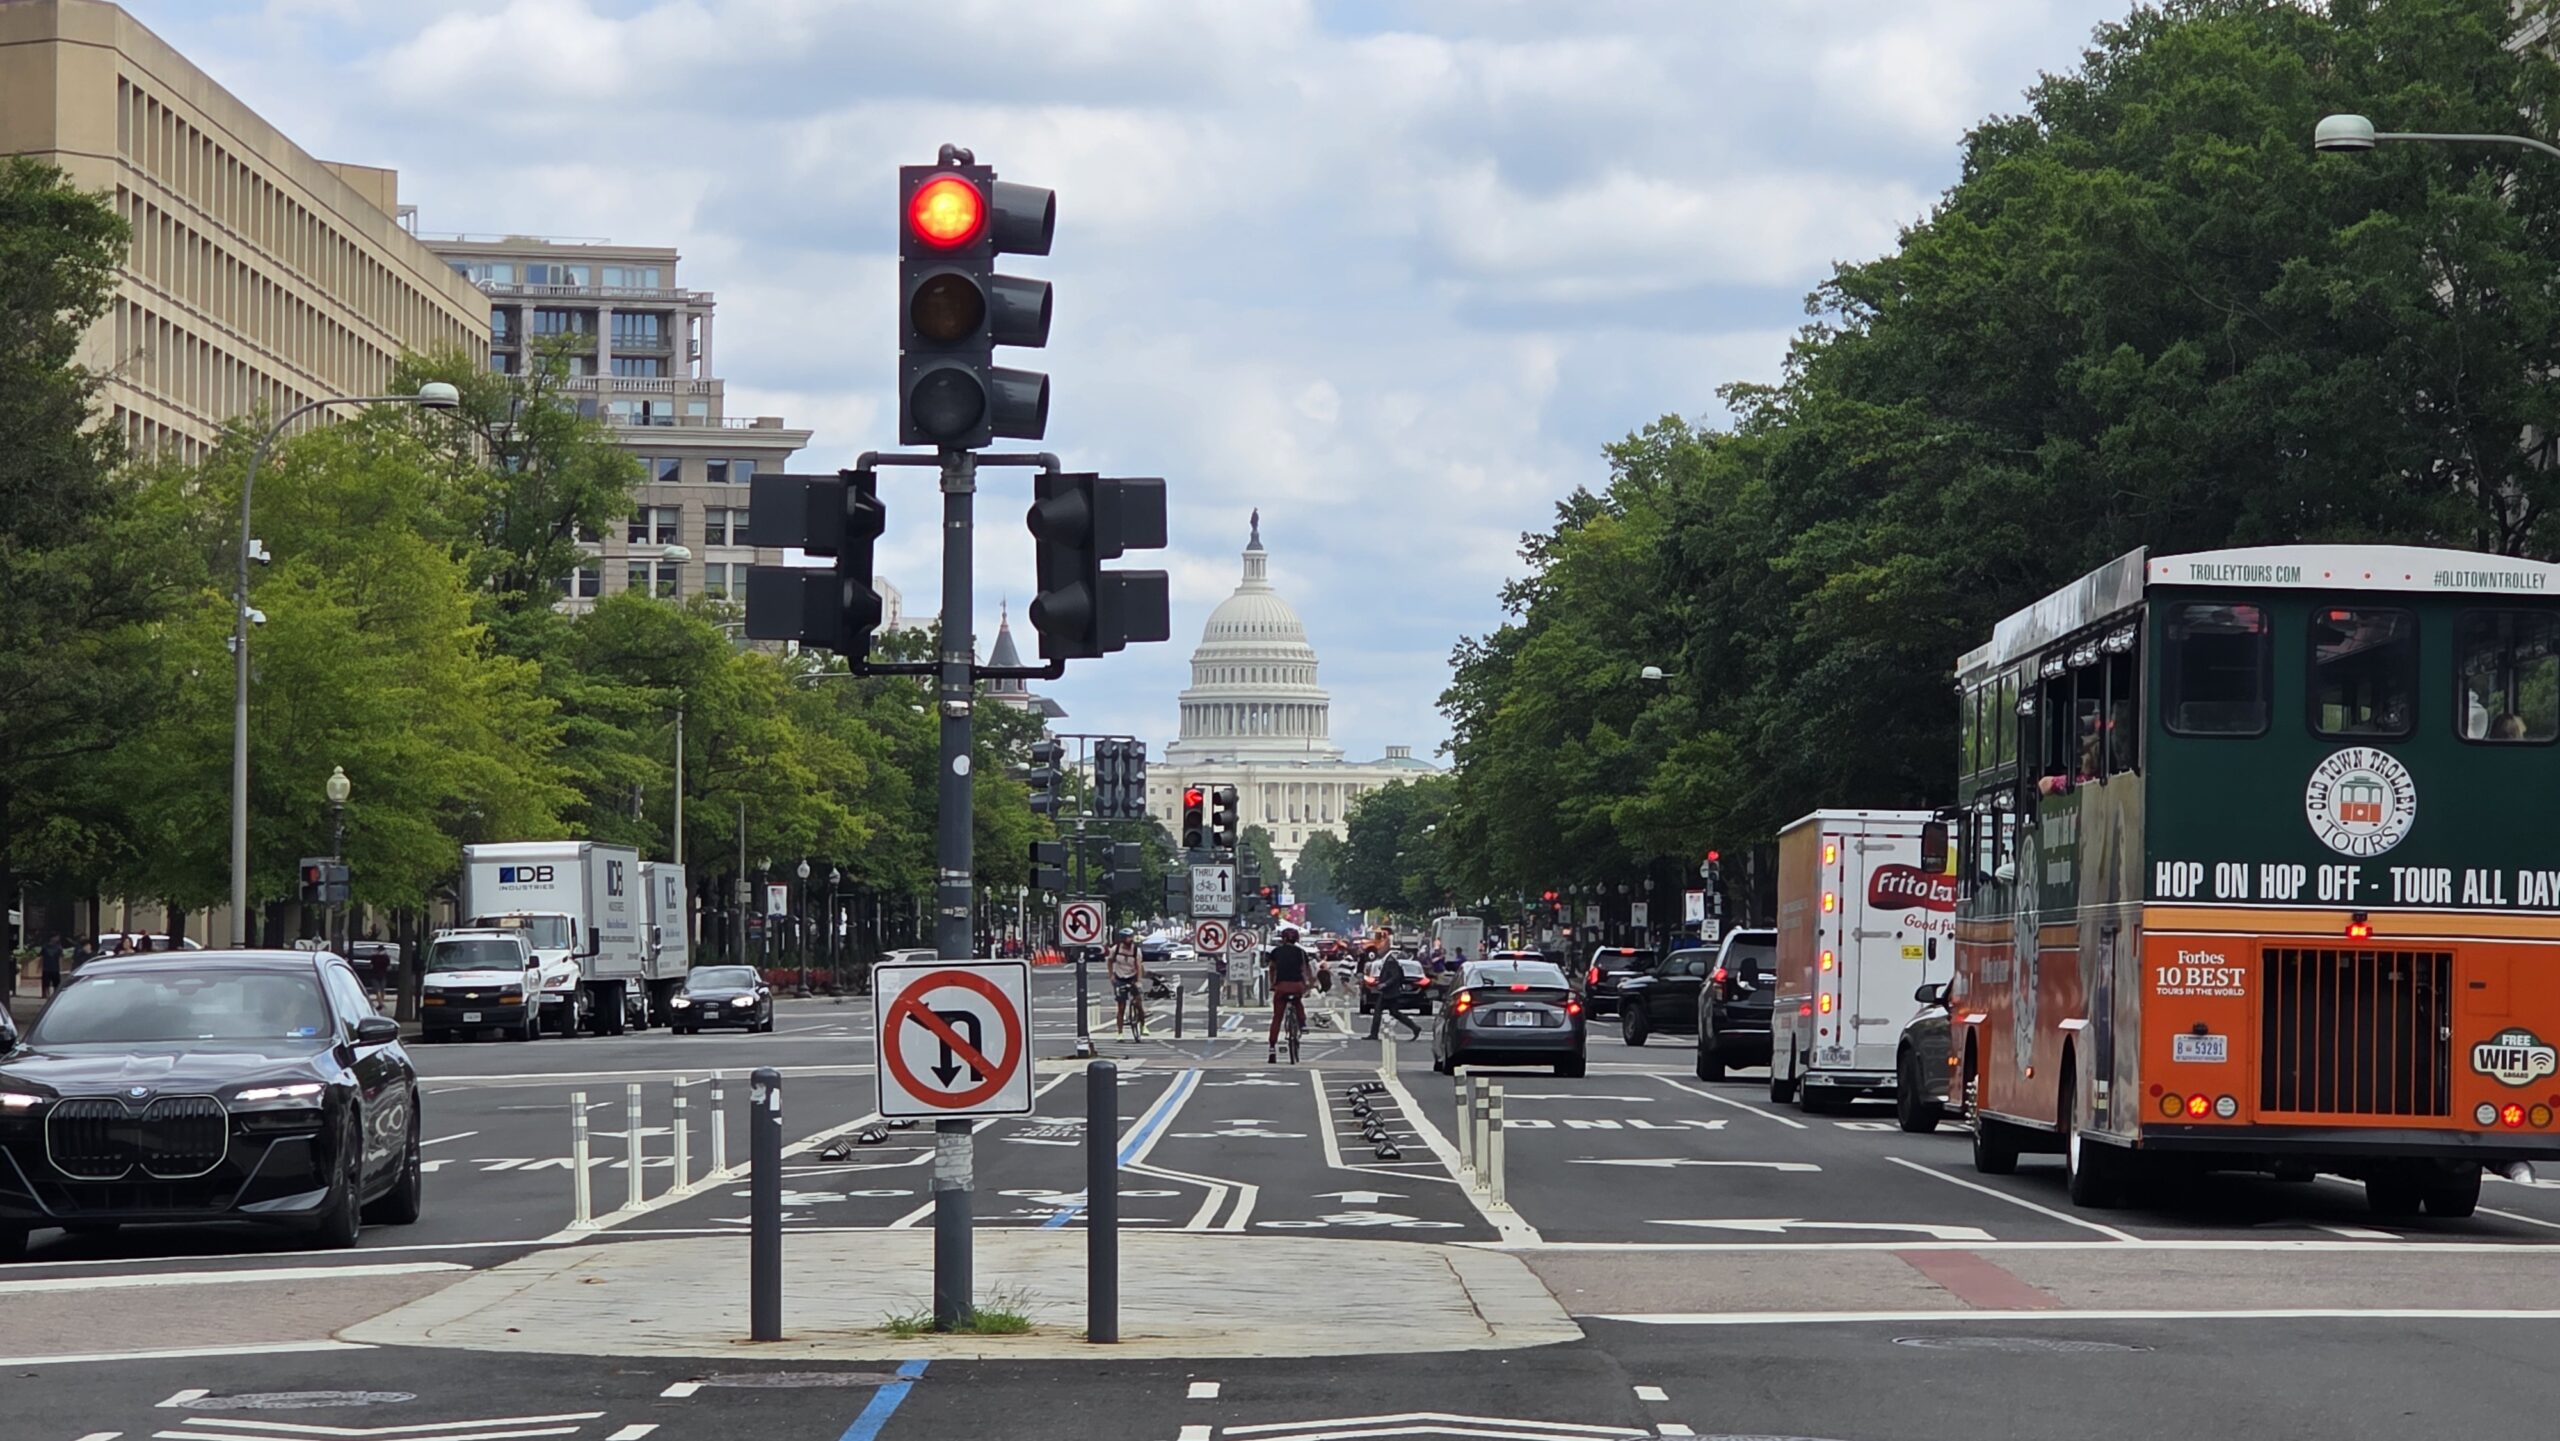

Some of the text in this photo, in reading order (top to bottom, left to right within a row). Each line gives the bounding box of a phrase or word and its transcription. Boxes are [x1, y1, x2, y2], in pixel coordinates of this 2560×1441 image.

[2434, 570, 2547, 589] #OLDTOWNTROLLEY
[2308, 749, 2415, 816] OLD TOWN TROLLEY
[2322, 819, 2400, 856] TOURS
[516, 865, 554, 882] DB
[1195, 868, 1214, 877] THRU
[1877, 871, 1928, 897] Frito
[1929, 880, 1957, 908] La
[2156, 861, 2203, 898] HOP
[2215, 863, 2249, 899] ON
[2260, 864, 2306, 900] HOP
[2318, 865, 2361, 901] OFF
[2390, 867, 2451, 904] TOUR
[2462, 869, 2507, 905] ALL
[2518, 870, 2560, 906] DAY
[1195, 894, 1232, 902] OBEY THIS
[1195, 904, 1219, 912] SIGNAL
[1904, 913, 1938, 930] Good
[2177, 950, 2225, 965] Forbes
[2156, 967, 2245, 987] 10 BEST
[2156, 987, 2245, 996] TOURS IN THE WORLD
[2501, 1034, 2532, 1046] FREE
[2195, 1043, 2223, 1055] 53291
[2479, 1048, 2529, 1071] WIFI
[1502, 1119, 1730, 1130] ONLY
